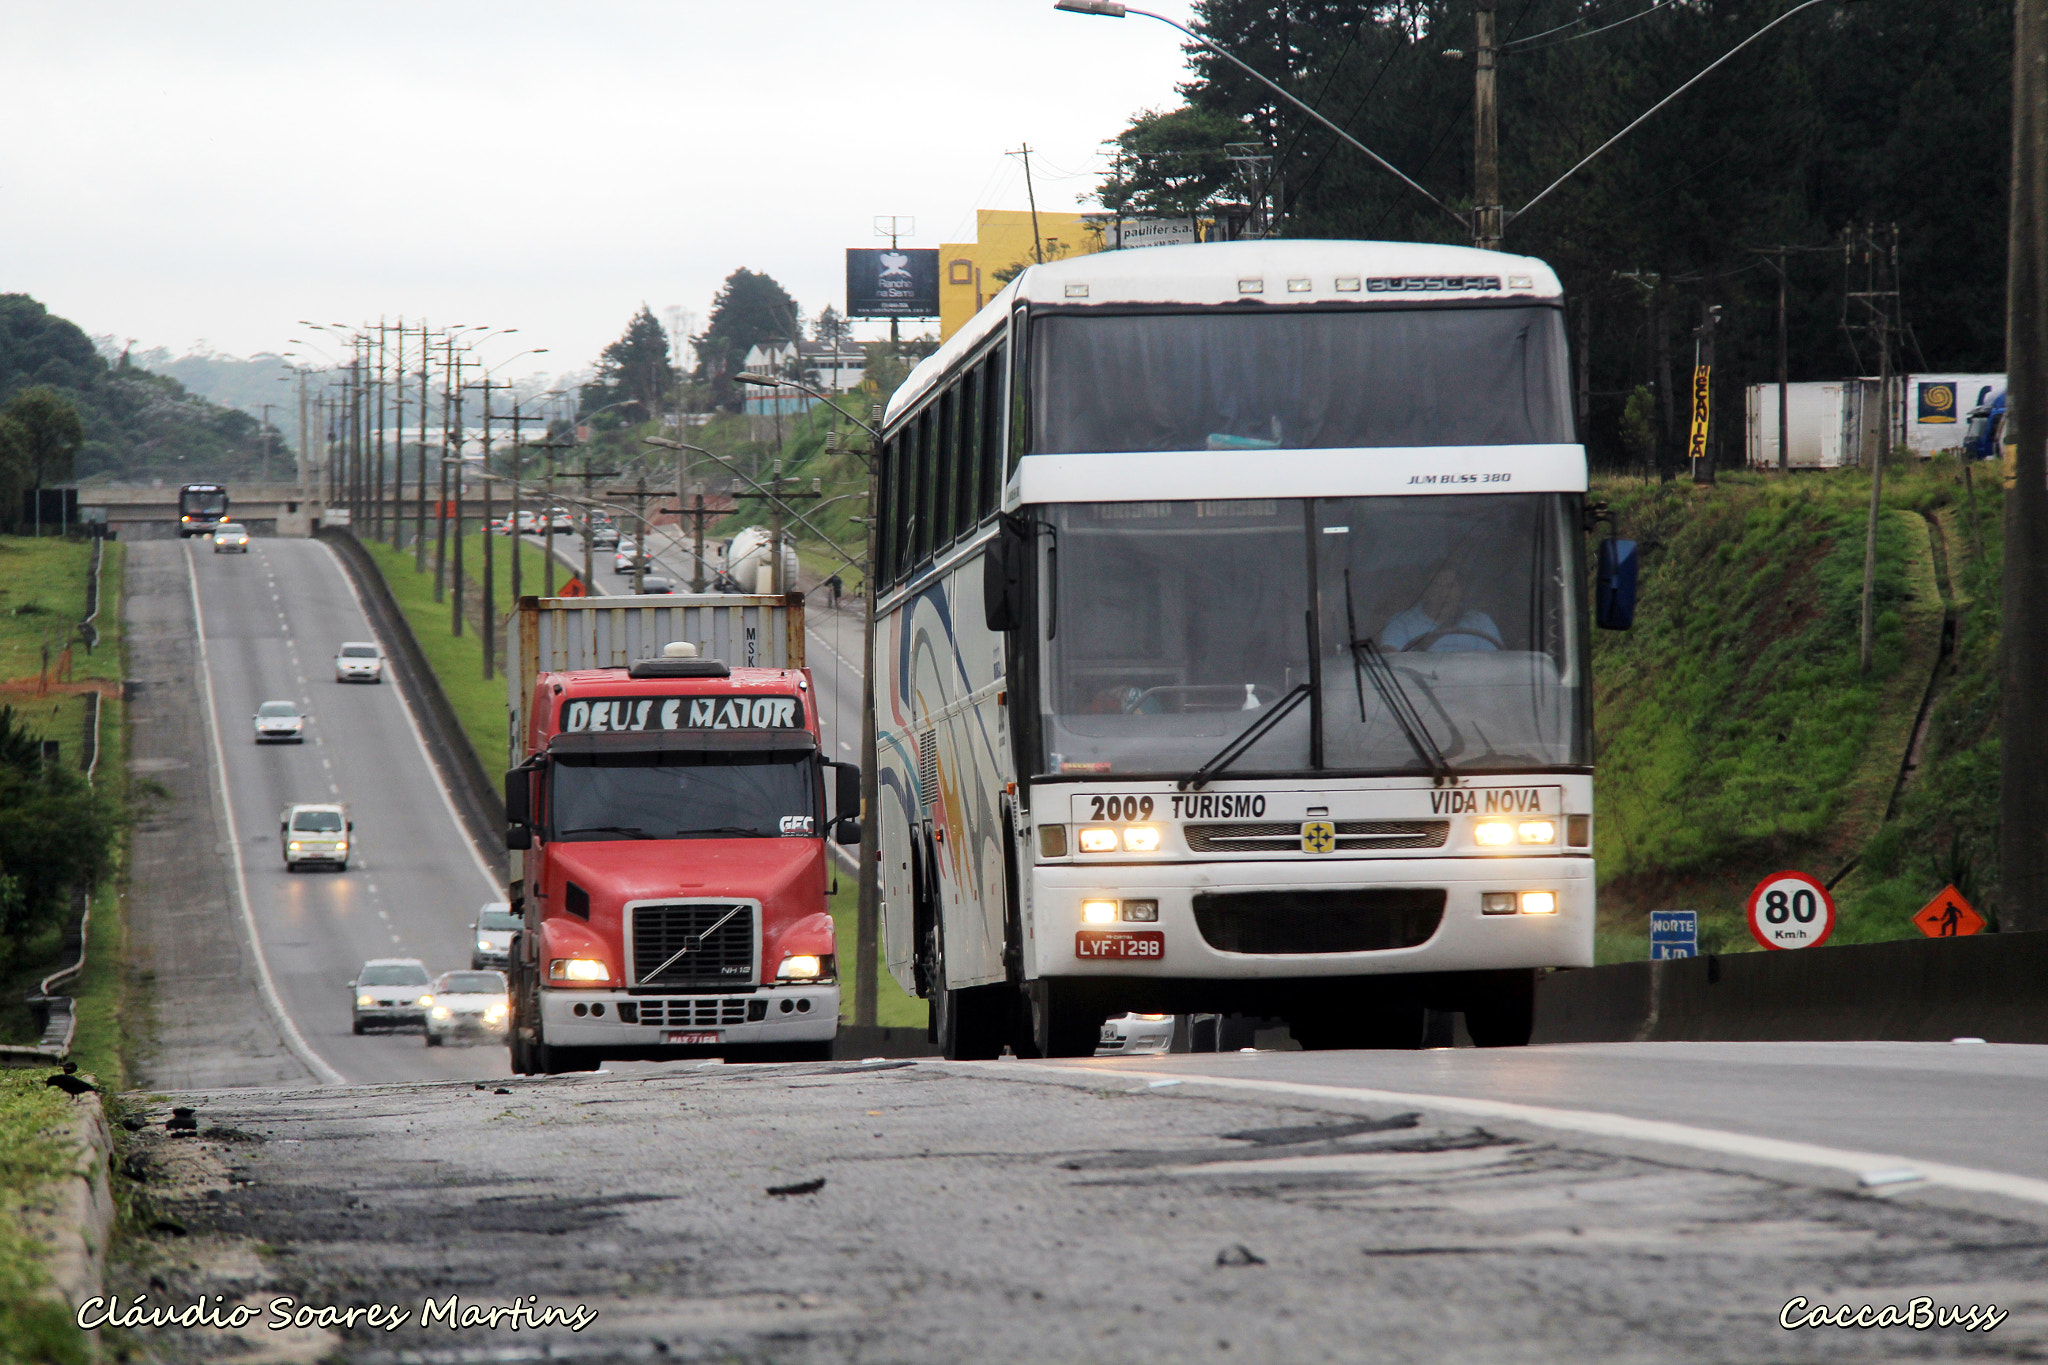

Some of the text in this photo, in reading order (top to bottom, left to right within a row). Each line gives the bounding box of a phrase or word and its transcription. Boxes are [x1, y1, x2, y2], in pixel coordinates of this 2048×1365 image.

[1124, 224, 1193, 239] paulifer s.a.
[1370, 277, 1499, 290] BUSSCAR
[1691, 365, 1709, 457] MECANICA
[1408, 473, 1511, 485] JUM BUSS 380
[567, 700, 653, 732] DEUS
[1090, 794, 1266, 821] 2009 TURISMO
[1430, 789, 1541, 814] VIDA NOVA
[1766, 889, 1817, 924] 80
[1652, 919, 1694, 932] NORTE
[1775, 930, 1807, 939] Km/h
